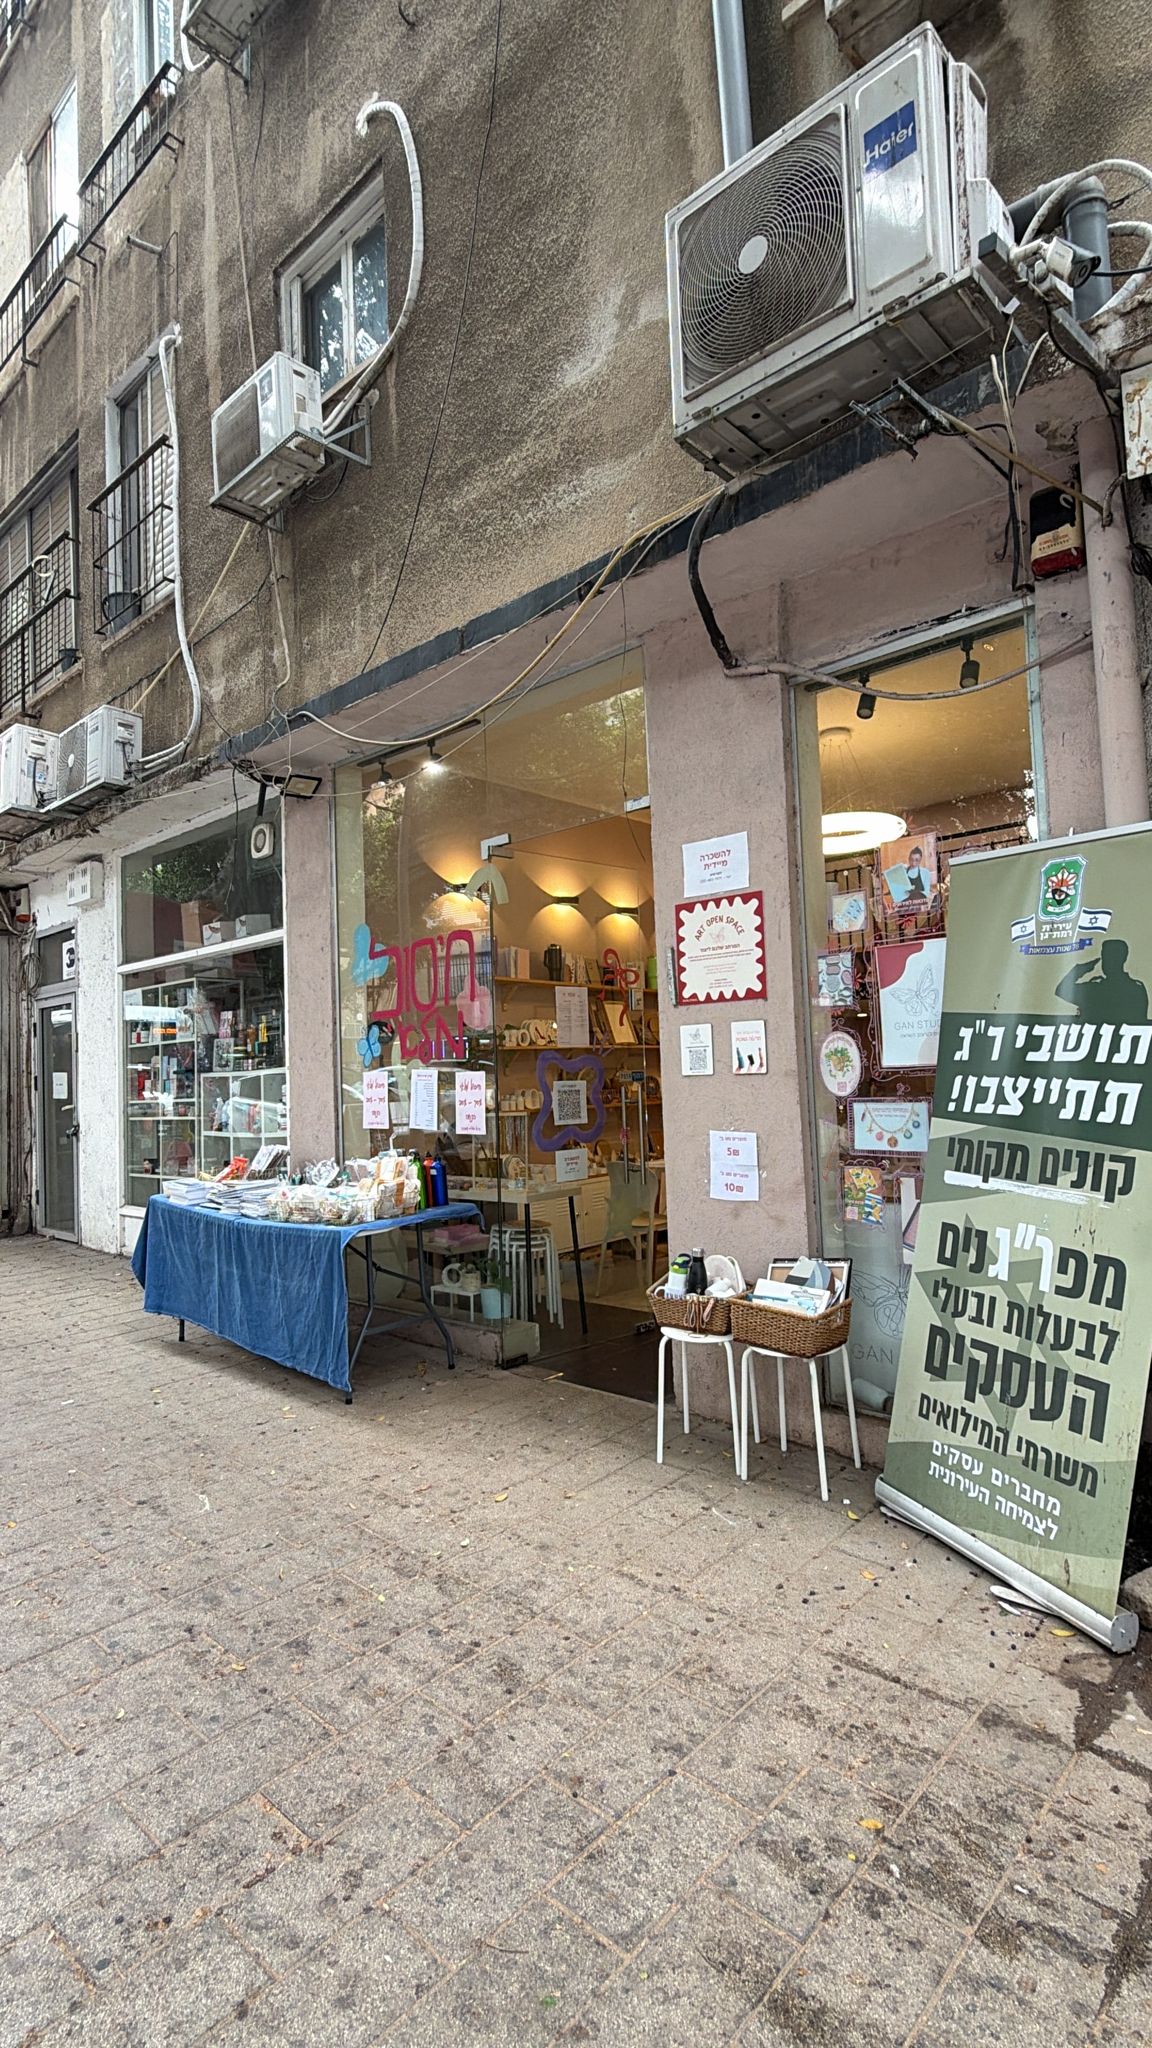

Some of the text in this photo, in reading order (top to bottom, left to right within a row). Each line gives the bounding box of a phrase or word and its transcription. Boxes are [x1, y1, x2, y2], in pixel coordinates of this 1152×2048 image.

[863, 121, 914, 168] Haier
[700, 849, 731, 862] להשכרה
[703, 860, 728, 871] מיידית
[694, 914, 745, 942] ART OPEN SPACE
[369, 928, 476, 1020] חיסול
[894, 1021, 914, 1031] GAN
[953, 1019, 1152, 1064] תושבי ר"ג
[947, 1074, 1143, 1126] תתייצבו!
[725, 1182, 744, 1193] 10₪
[947, 1136, 1137, 1204] קונים מקומי
[932, 1277, 1121, 1366] לבעלות ובעלי
[924, 1323, 1111, 1444] העסקים
[918, 1392, 1099, 1499] משרתי המילואים
[928, 1460, 1059, 1541] לצמיחה העירונית
[932, 1439, 1062, 1517] מחברים עסקים
